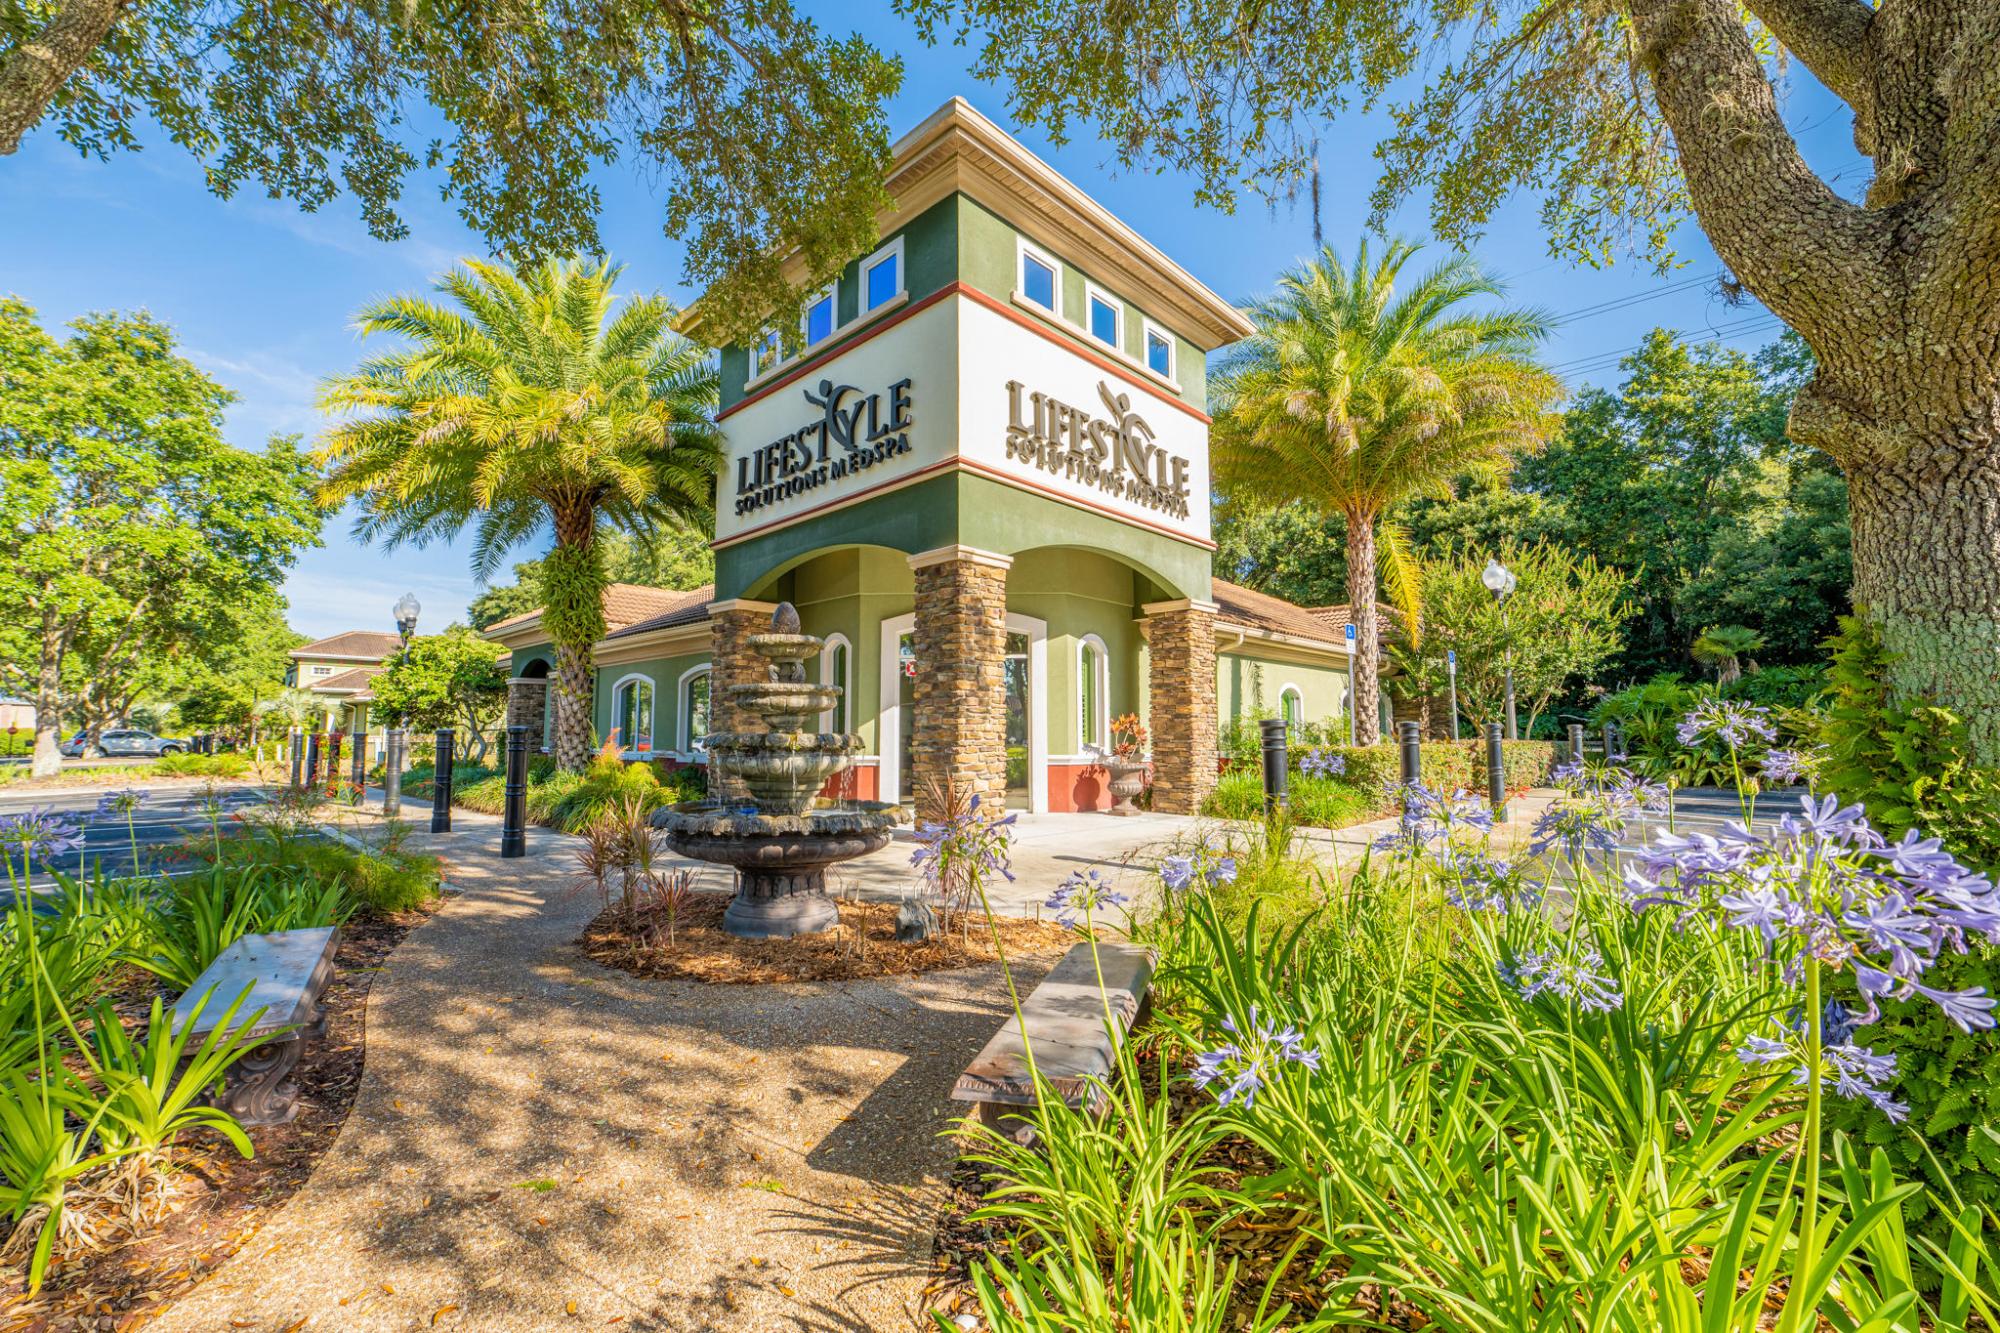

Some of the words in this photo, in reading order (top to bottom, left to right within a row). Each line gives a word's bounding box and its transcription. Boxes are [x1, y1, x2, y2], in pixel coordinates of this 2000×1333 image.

[735, 466, 828, 516] SOLUTIONS
[830, 433, 912, 480] MEDSPA
[737, 378, 911, 495] LIFESTYLE
[1005, 380, 1190, 499] LIFESTYLE
[1006, 434, 1125, 498] SOLUTIONS
